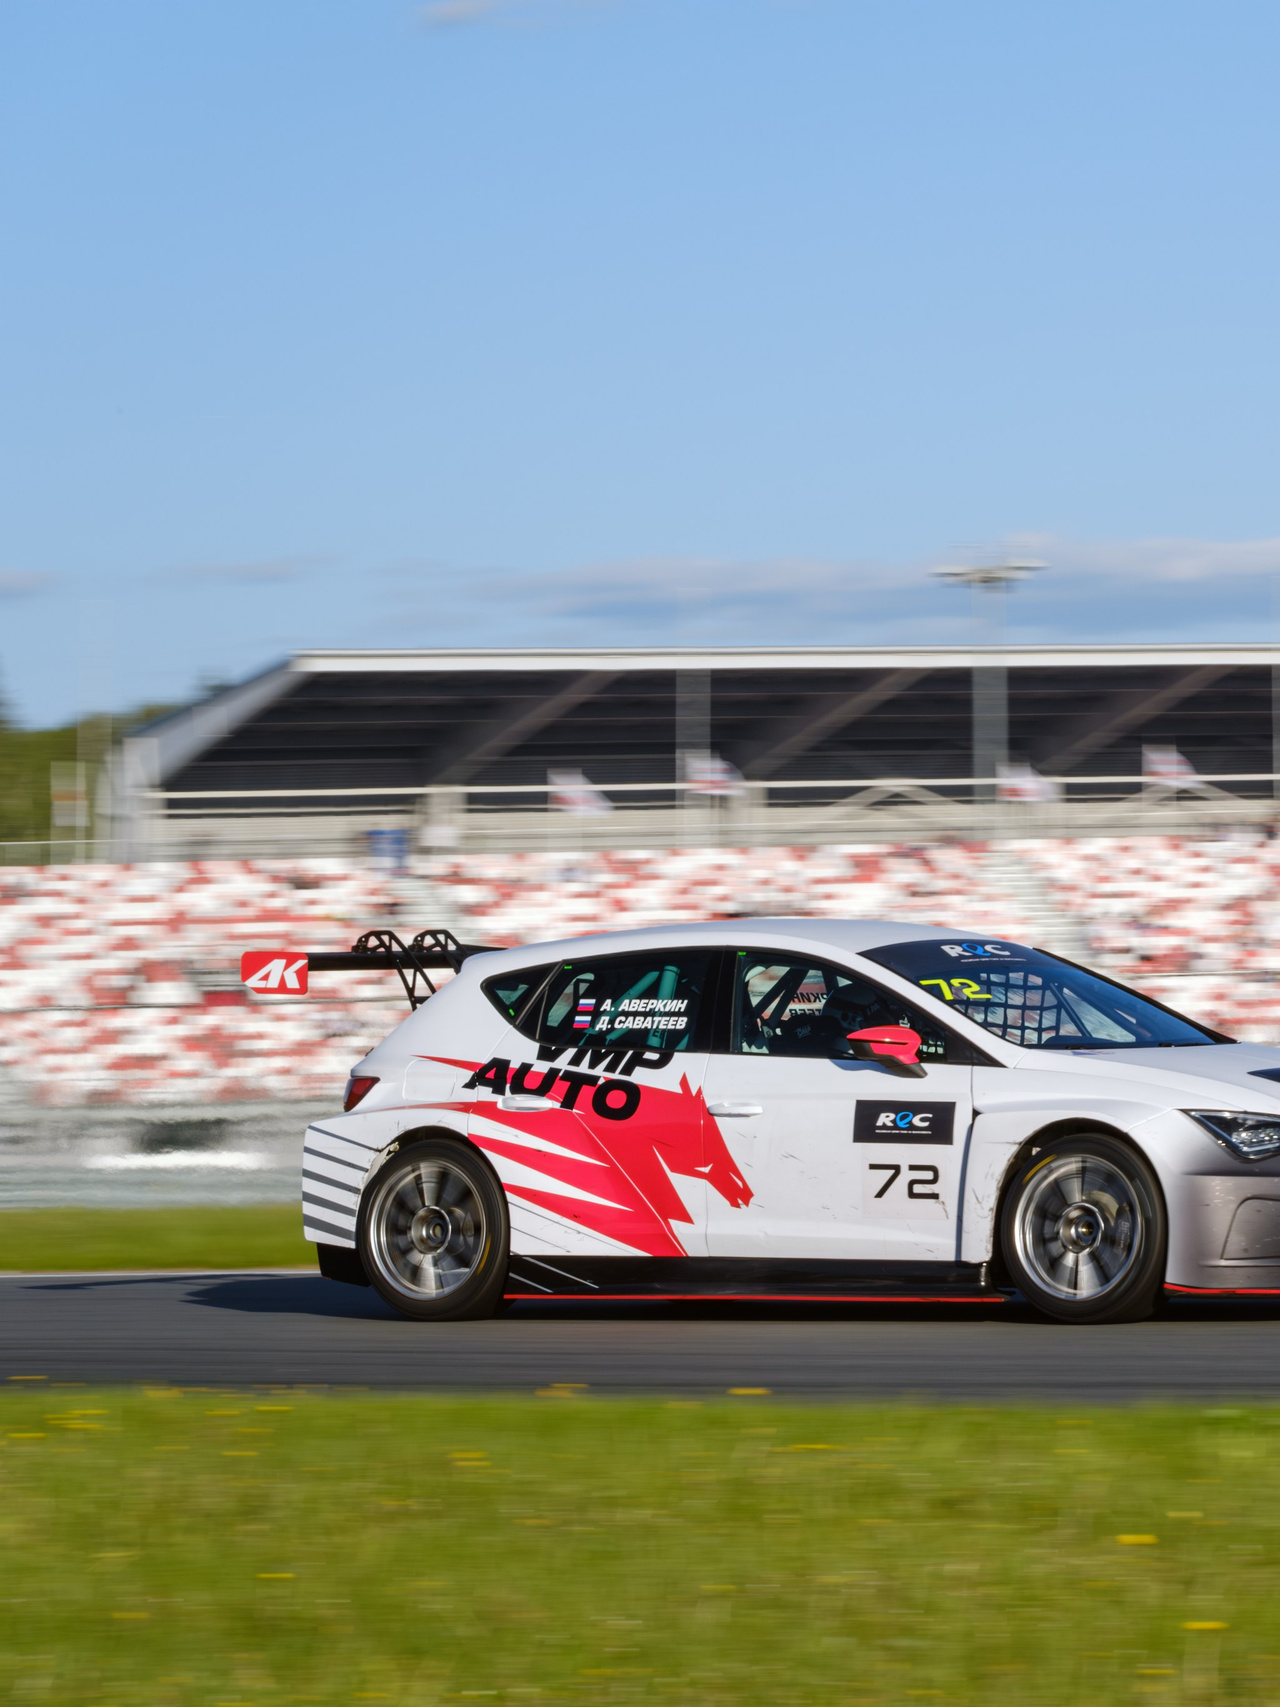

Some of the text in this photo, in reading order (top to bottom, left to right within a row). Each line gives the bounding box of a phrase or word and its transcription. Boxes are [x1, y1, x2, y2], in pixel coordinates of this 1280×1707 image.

[919, 978, 993, 1000] 72
[600, 999, 688, 1012] А. АВЕРКИН
[595, 1016, 688, 1031] Д. САВАТЕЕВ
[536, 1045, 675, 1077] VMP
[461, 1057, 641, 1121] AUTO
[869, 1163, 939, 1200] 72
